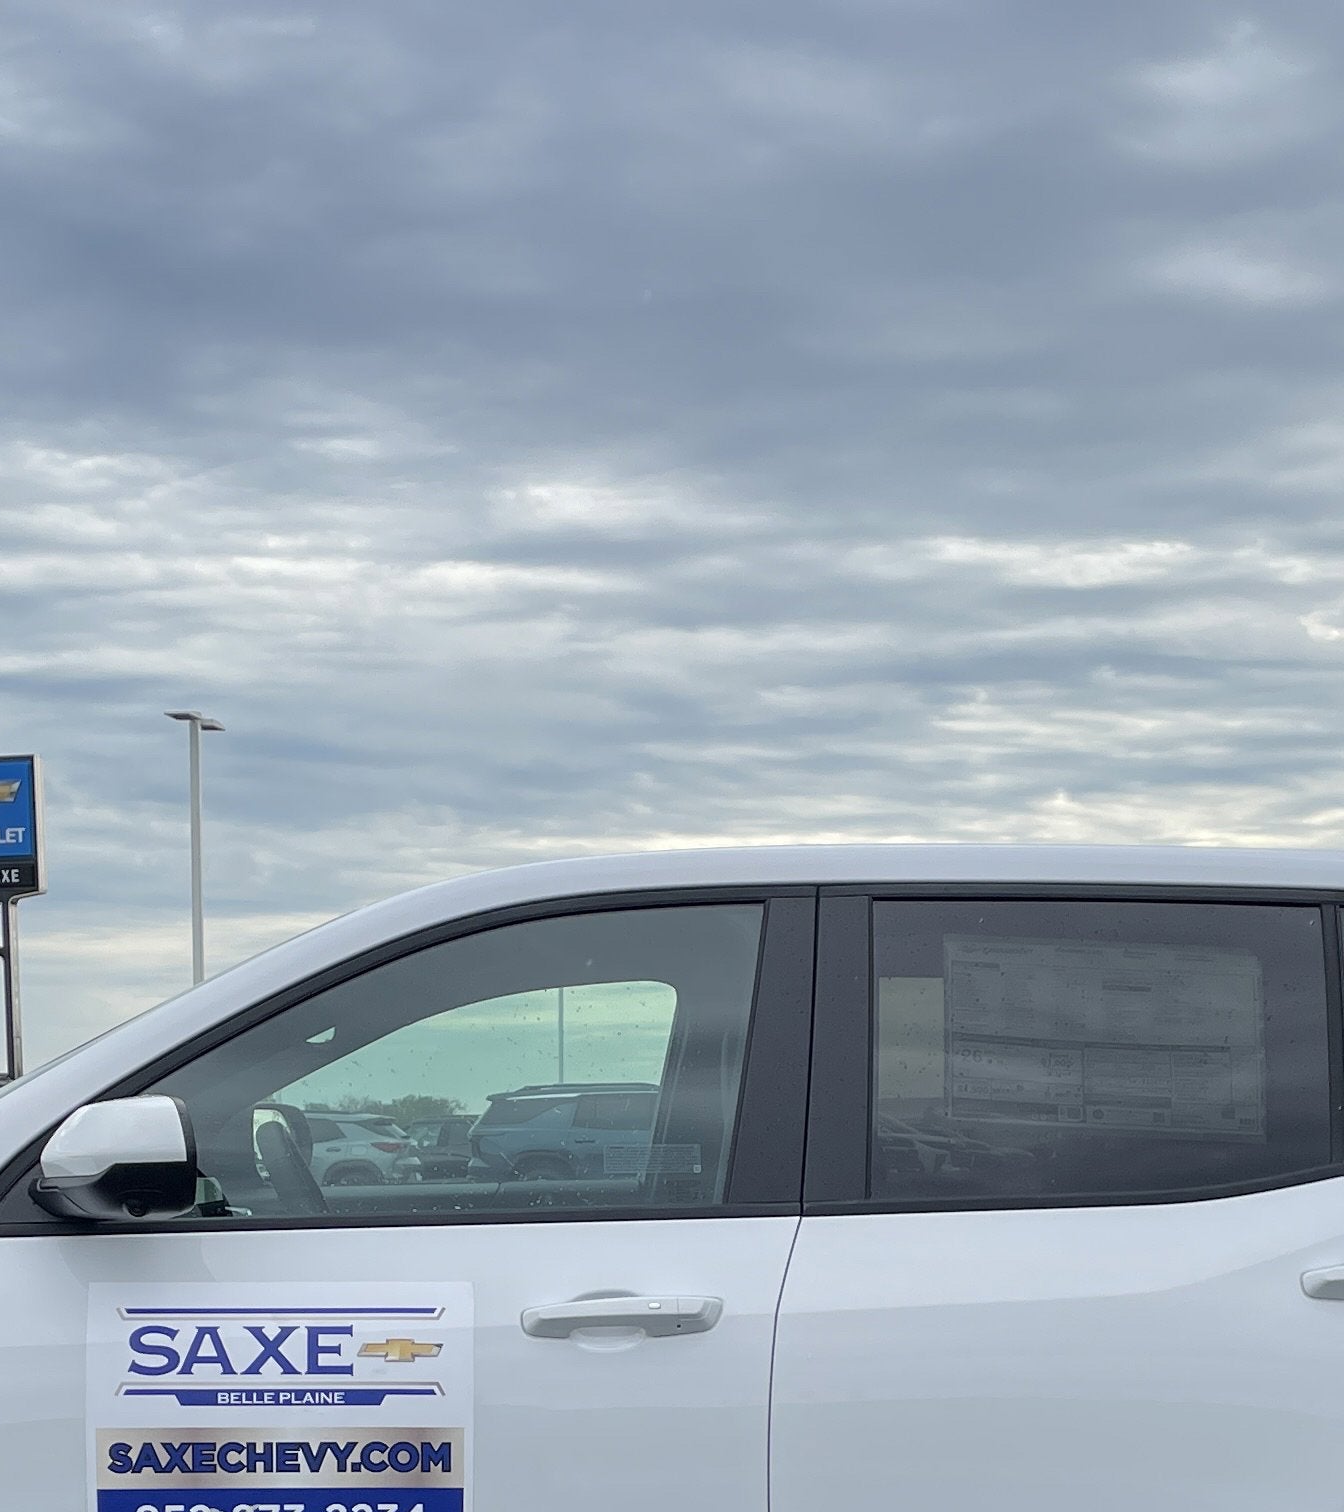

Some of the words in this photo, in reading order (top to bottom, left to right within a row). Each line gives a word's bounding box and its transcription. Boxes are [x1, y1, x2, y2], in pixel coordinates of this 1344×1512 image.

[128, 1324, 354, 1376] SAXE
[217, 1392, 276, 1404] BELLE
[279, 1391, 346, 1404] PLAINE
[107, 1441, 452, 1474] SAXECHEVY.COM
